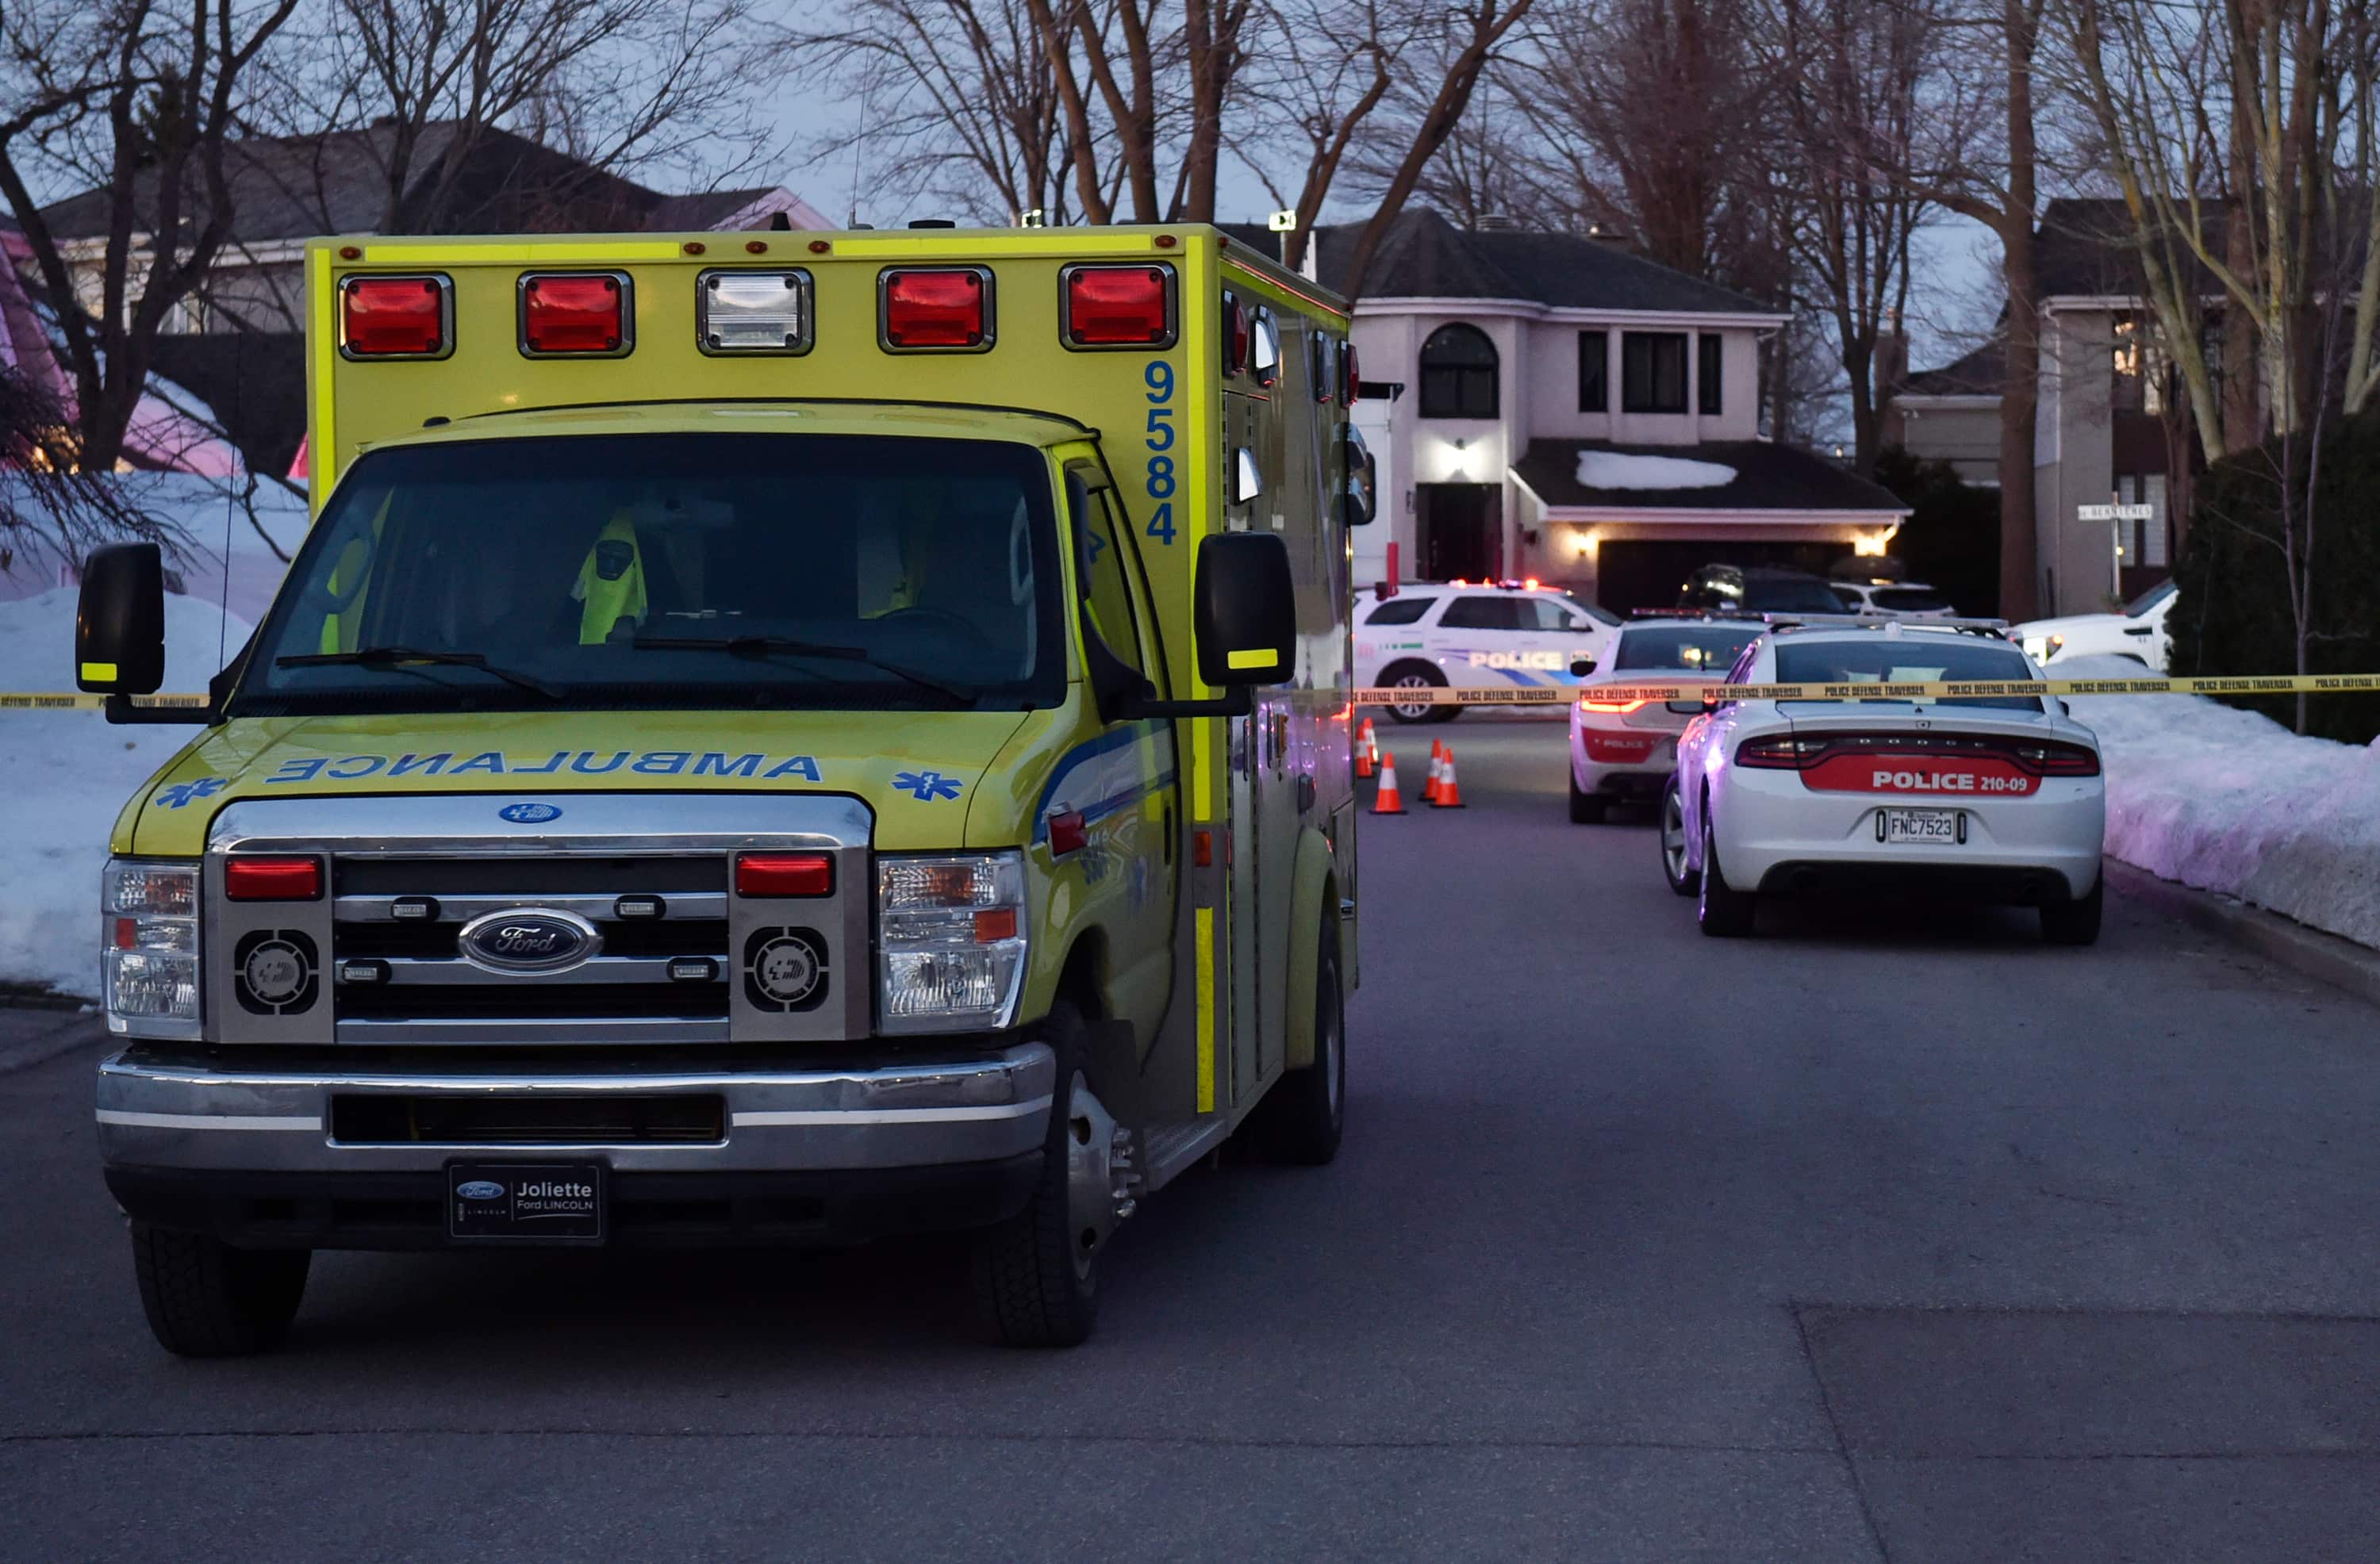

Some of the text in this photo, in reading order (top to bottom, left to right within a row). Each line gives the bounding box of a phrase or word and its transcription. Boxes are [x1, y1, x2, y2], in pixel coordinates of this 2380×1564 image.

[1144, 360, 1177, 546] 9584
[1470, 651, 1563, 671] POLICE
[2070, 682, 2094, 692] POLICE
[2130, 681, 2171, 692] TRAVERSER
[2193, 680, 2217, 691] POLICE
[2252, 679, 2293, 689] TRAVERSER
[2316, 679, 2340, 688] POLICE
[1457, 691, 1481, 700] POLICE
[1517, 690, 1557, 700] TRAVERSER
[1580, 689, 1603, 700] POLICE
[1640, 688, 1679, 699] TRAVERSER
[1702, 688, 1726, 698] POLICE
[1763, 687, 1802, 697] TRAVERSER
[1825, 686, 1848, 696] POLICE
[1885, 685, 1925, 696] TRAVERSER
[1948, 684, 1971, 695] POLICE
[2008, 684, 2048, 694] TRAVERSER
[1394, 691, 1434, 702] TRAVERSER
[1603, 739, 1644, 749] POLICE
[1873, 771, 2028, 792] POLICE 210-09
[1891, 818, 1952, 836] FNC7523
[495, 926, 556, 952] Ford
[517, 1182, 592, 1198] Joliette
[517, 1200, 593, 1210] Ford LINCOLN
